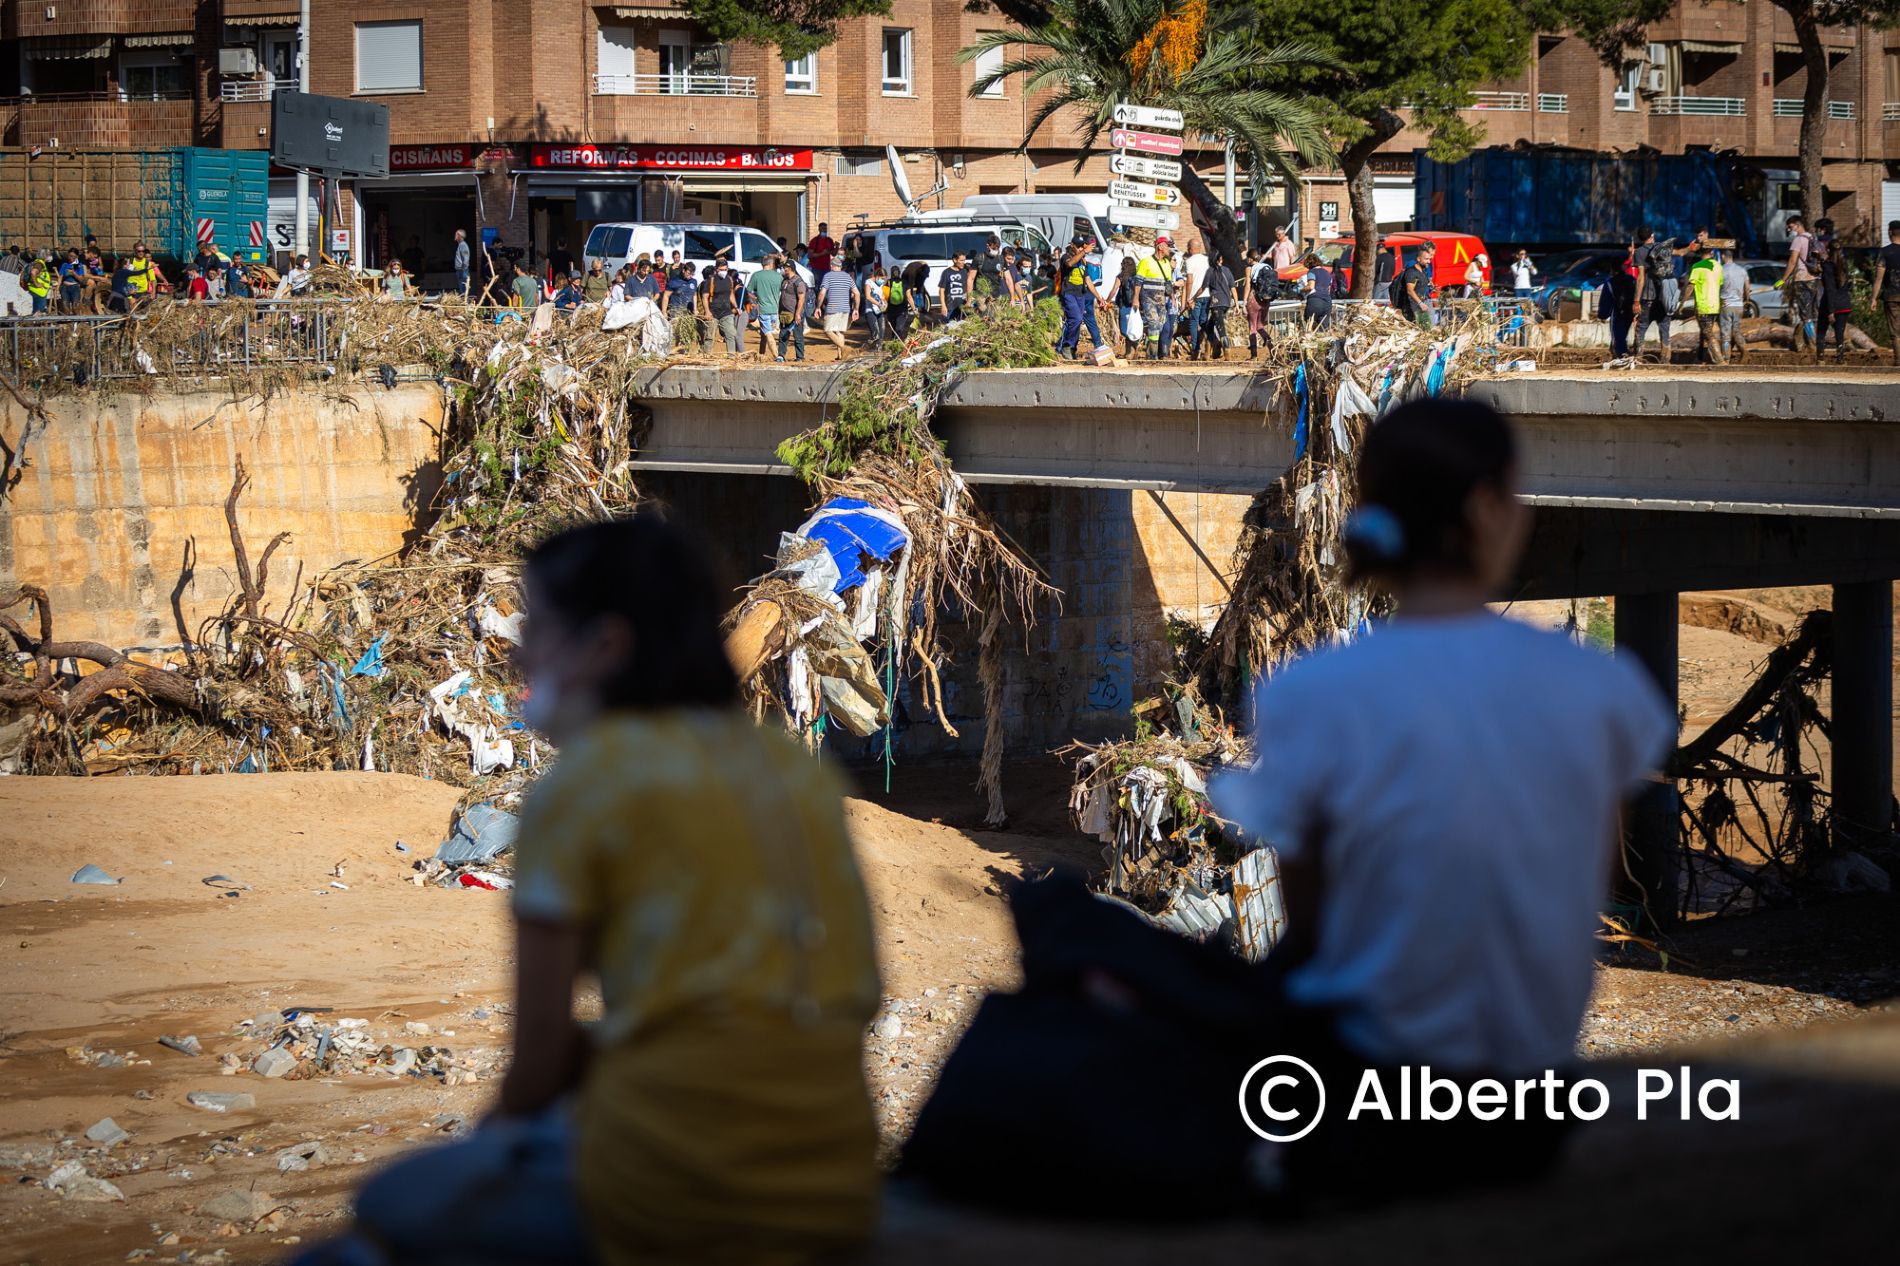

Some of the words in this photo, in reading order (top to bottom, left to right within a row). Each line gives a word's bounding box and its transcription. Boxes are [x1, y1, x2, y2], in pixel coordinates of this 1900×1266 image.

[391, 149, 464, 165] CISMANS
[550, 150, 639, 165] REFORMAS
[655, 151, 726, 166] COCINAS
[950, 273, 964, 301] 1973
